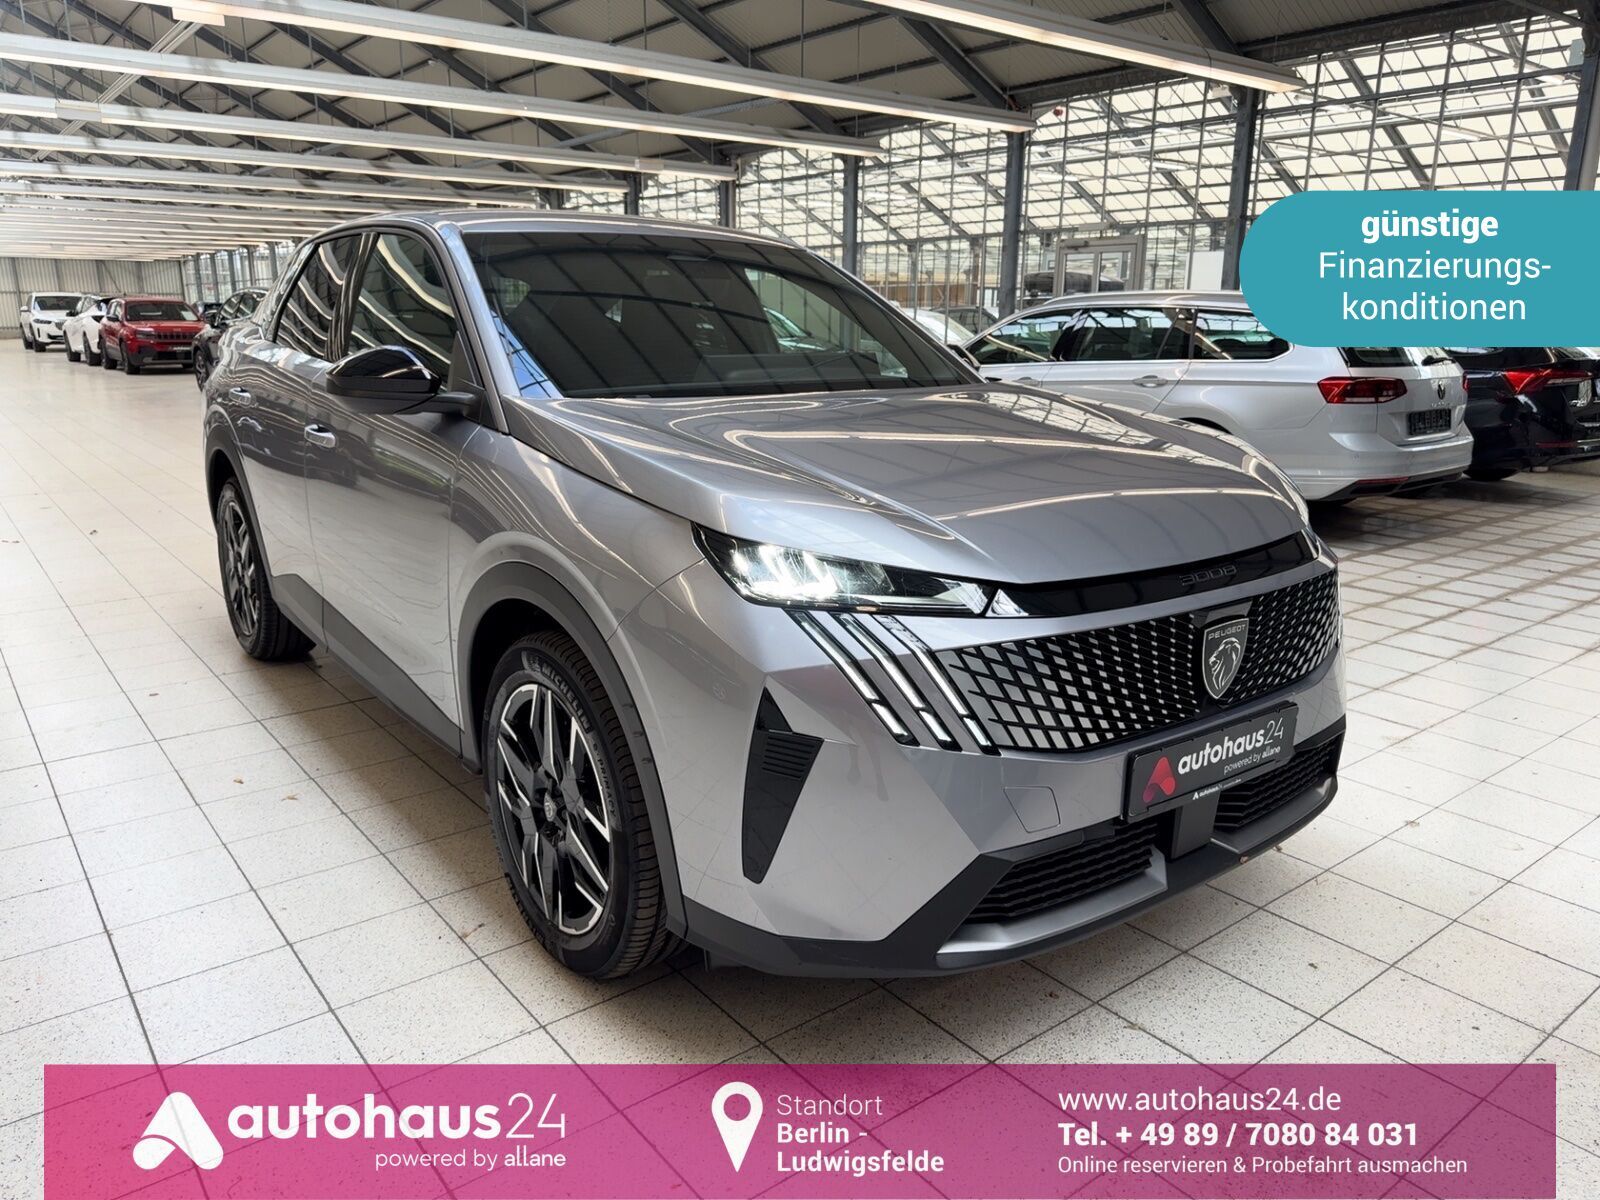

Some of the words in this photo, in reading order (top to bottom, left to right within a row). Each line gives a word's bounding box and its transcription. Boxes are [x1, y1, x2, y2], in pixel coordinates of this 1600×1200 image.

[1179, 565, 1237, 586] 3008
[1208, 624, 1246, 640] PEUGEOT
[541, 662, 592, 731] MICHELIN
[1177, 717, 1284, 775] autohaus24
[1223, 755, 1252, 776] powered
[1252, 752, 1261, 764] by
[1261, 745, 1281, 760] allane
